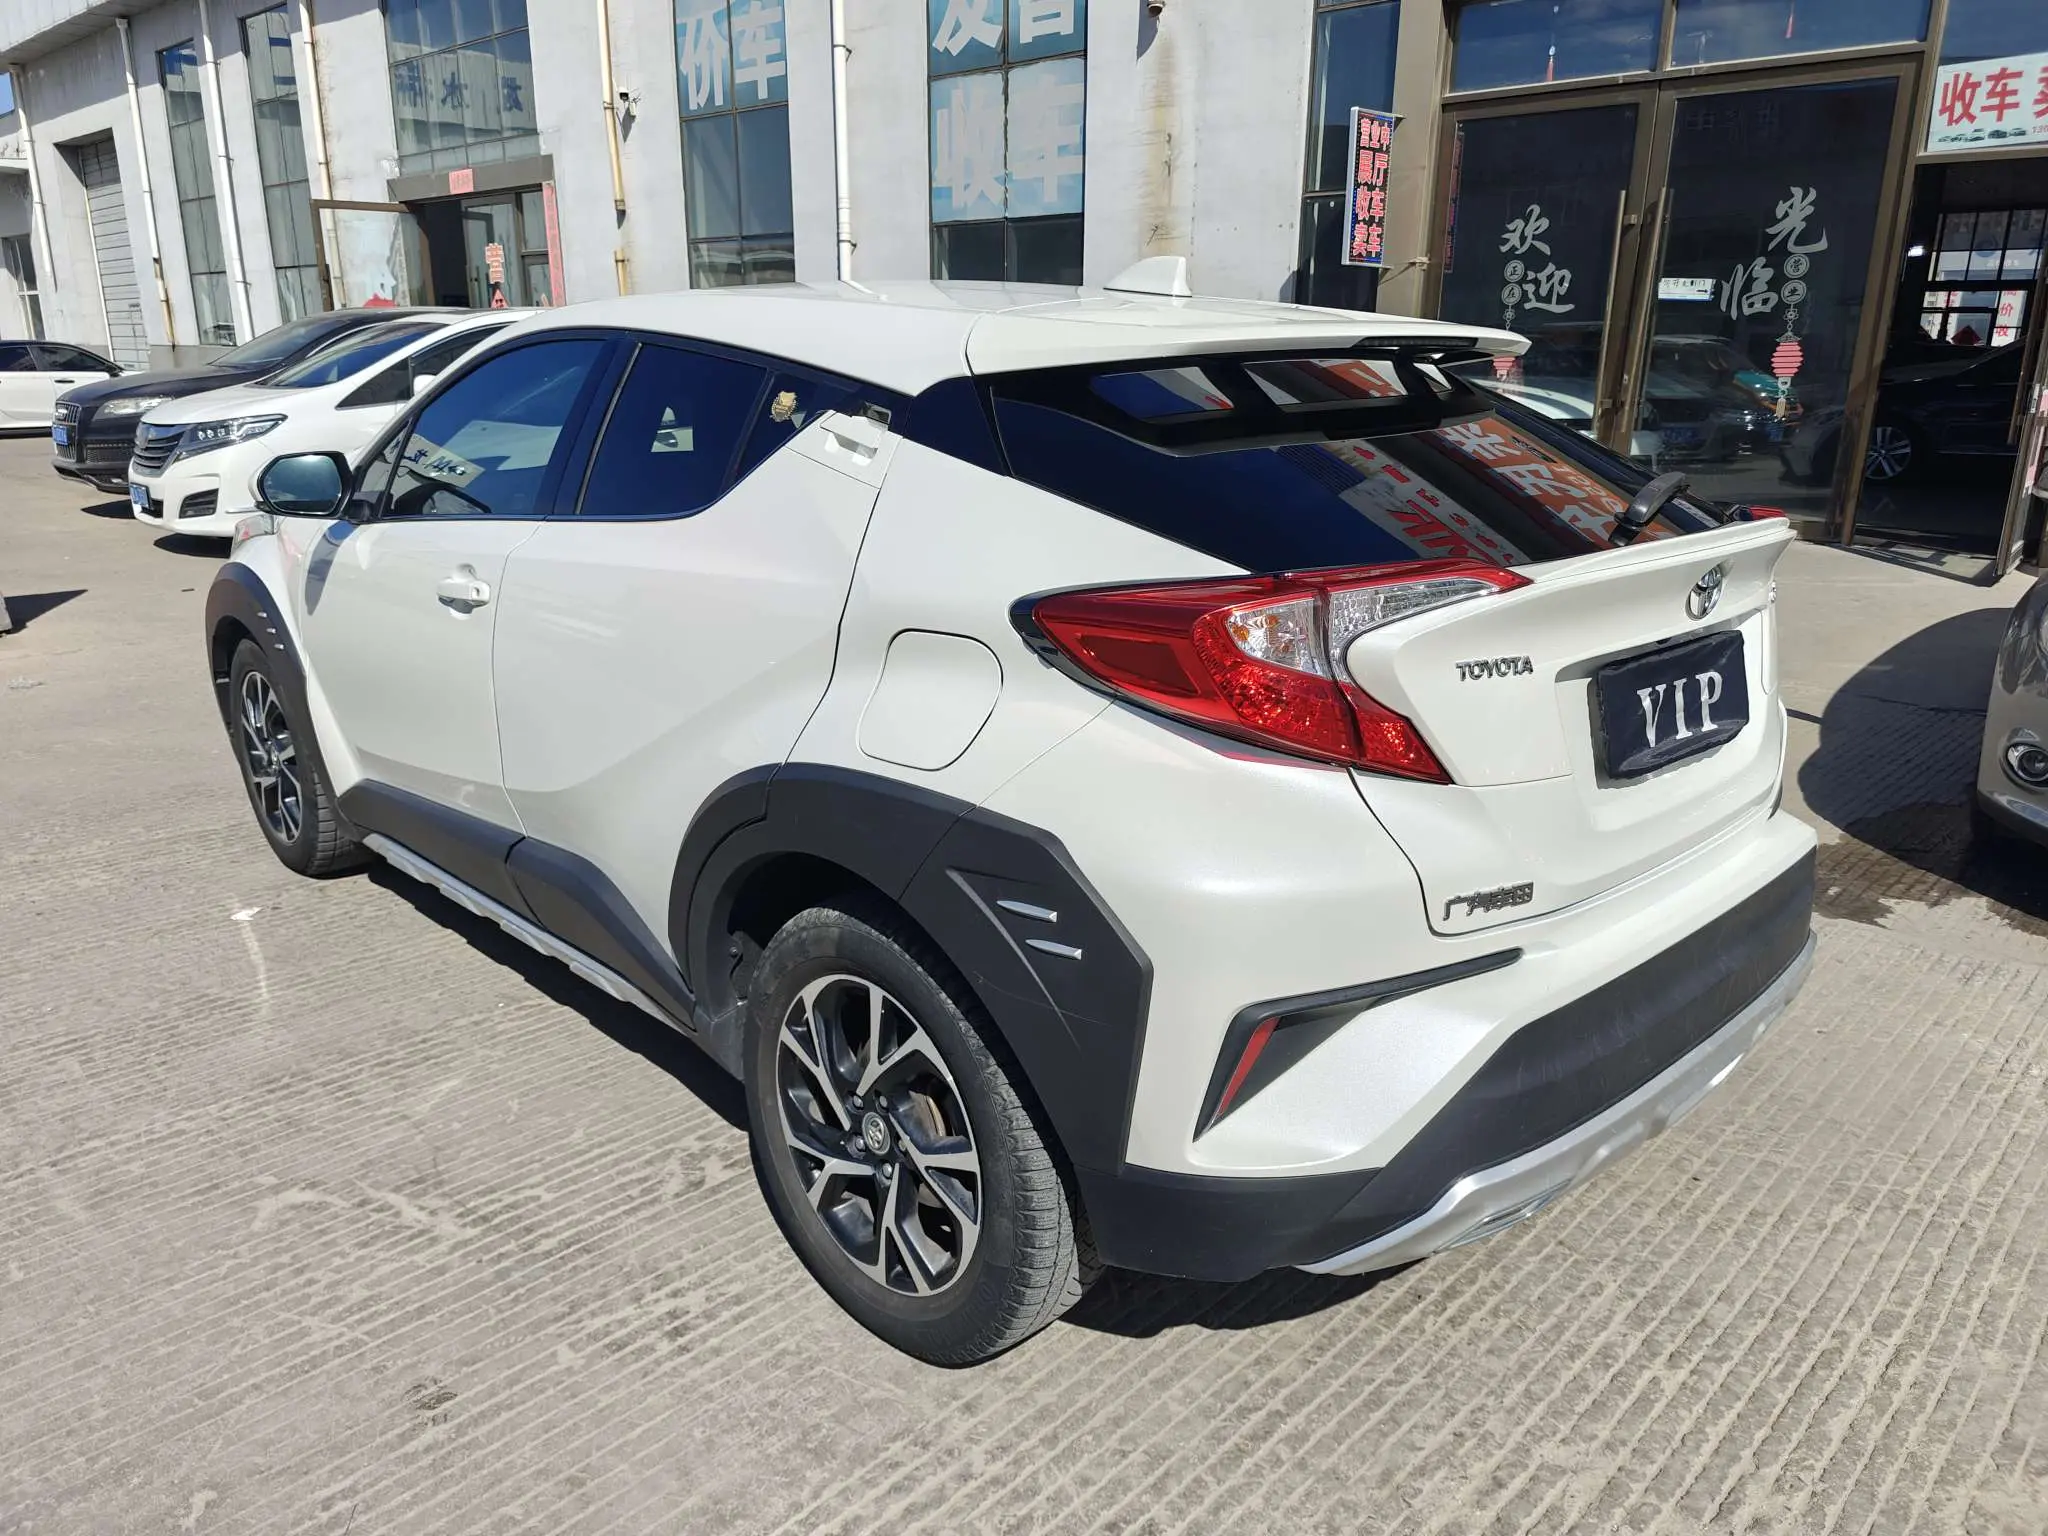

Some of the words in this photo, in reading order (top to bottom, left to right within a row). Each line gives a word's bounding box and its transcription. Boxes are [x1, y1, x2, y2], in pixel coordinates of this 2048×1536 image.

[1358, 150, 1389, 187] 展厅
[1355, 186, 1384, 222] 收车
[1353, 222, 1382, 258] 卖车
[1719, 186, 1828, 320] 光临
[1499, 204, 1576, 314] 欢迎
[1455, 656, 1533, 681] TOYOTA
[1636, 671, 1722, 748] VIP
